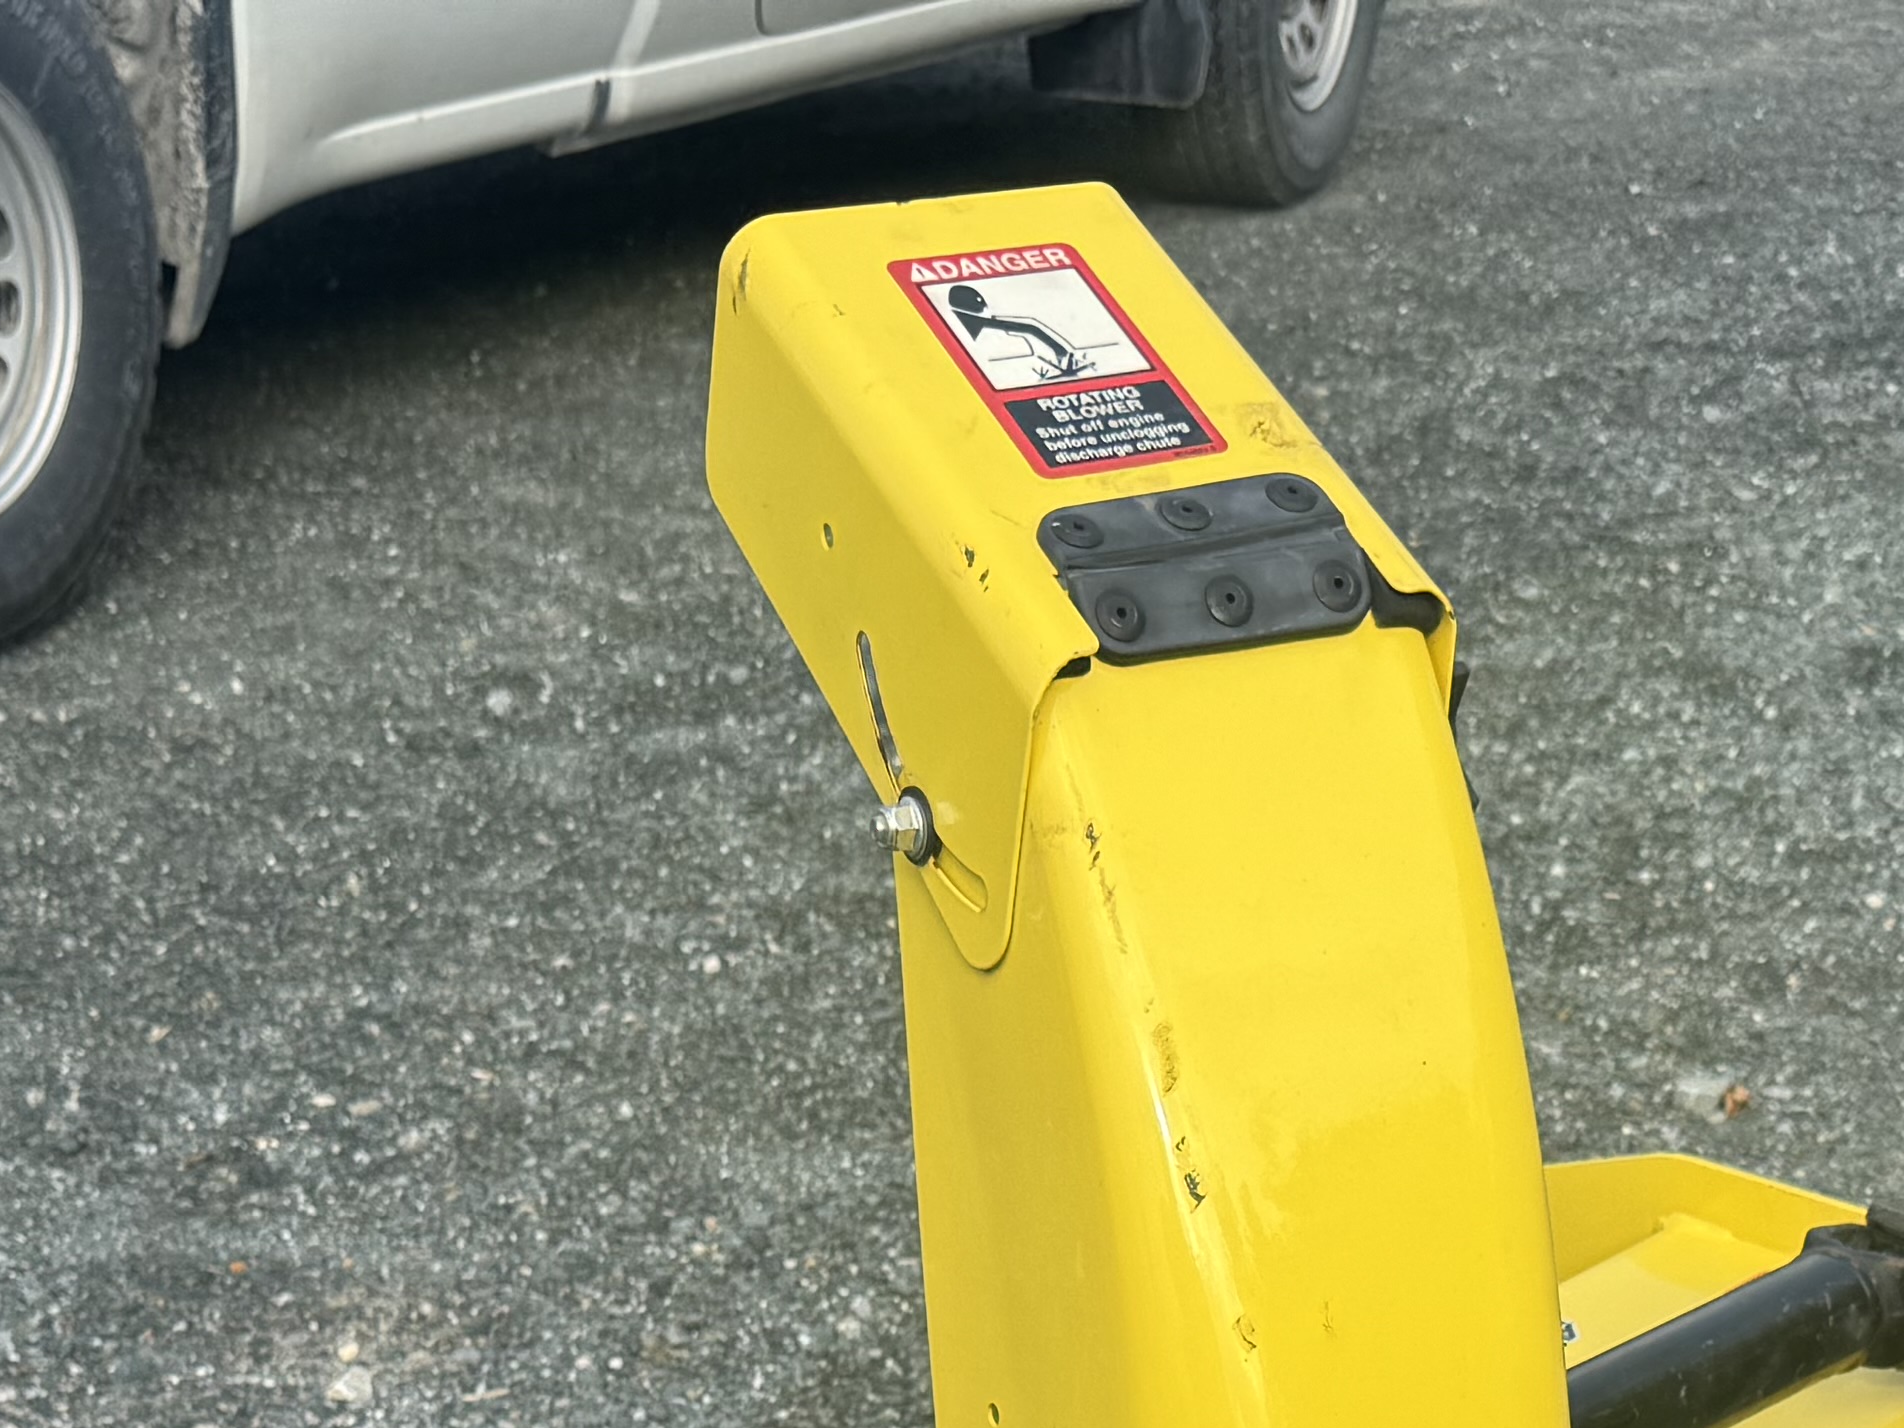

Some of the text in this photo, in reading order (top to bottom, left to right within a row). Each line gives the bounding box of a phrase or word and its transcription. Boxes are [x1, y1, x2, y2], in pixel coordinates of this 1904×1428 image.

[932, 248, 1072, 279] DANGER
[1036, 386, 1141, 411] ROTATING
[1052, 400, 1145, 422] BLOWER
[1035, 412, 1165, 439] Shut off engine
[1043, 421, 1190, 452] before unclogging
[1055, 443, 1134, 464] discharge
[1137, 436, 1182, 451] chute
